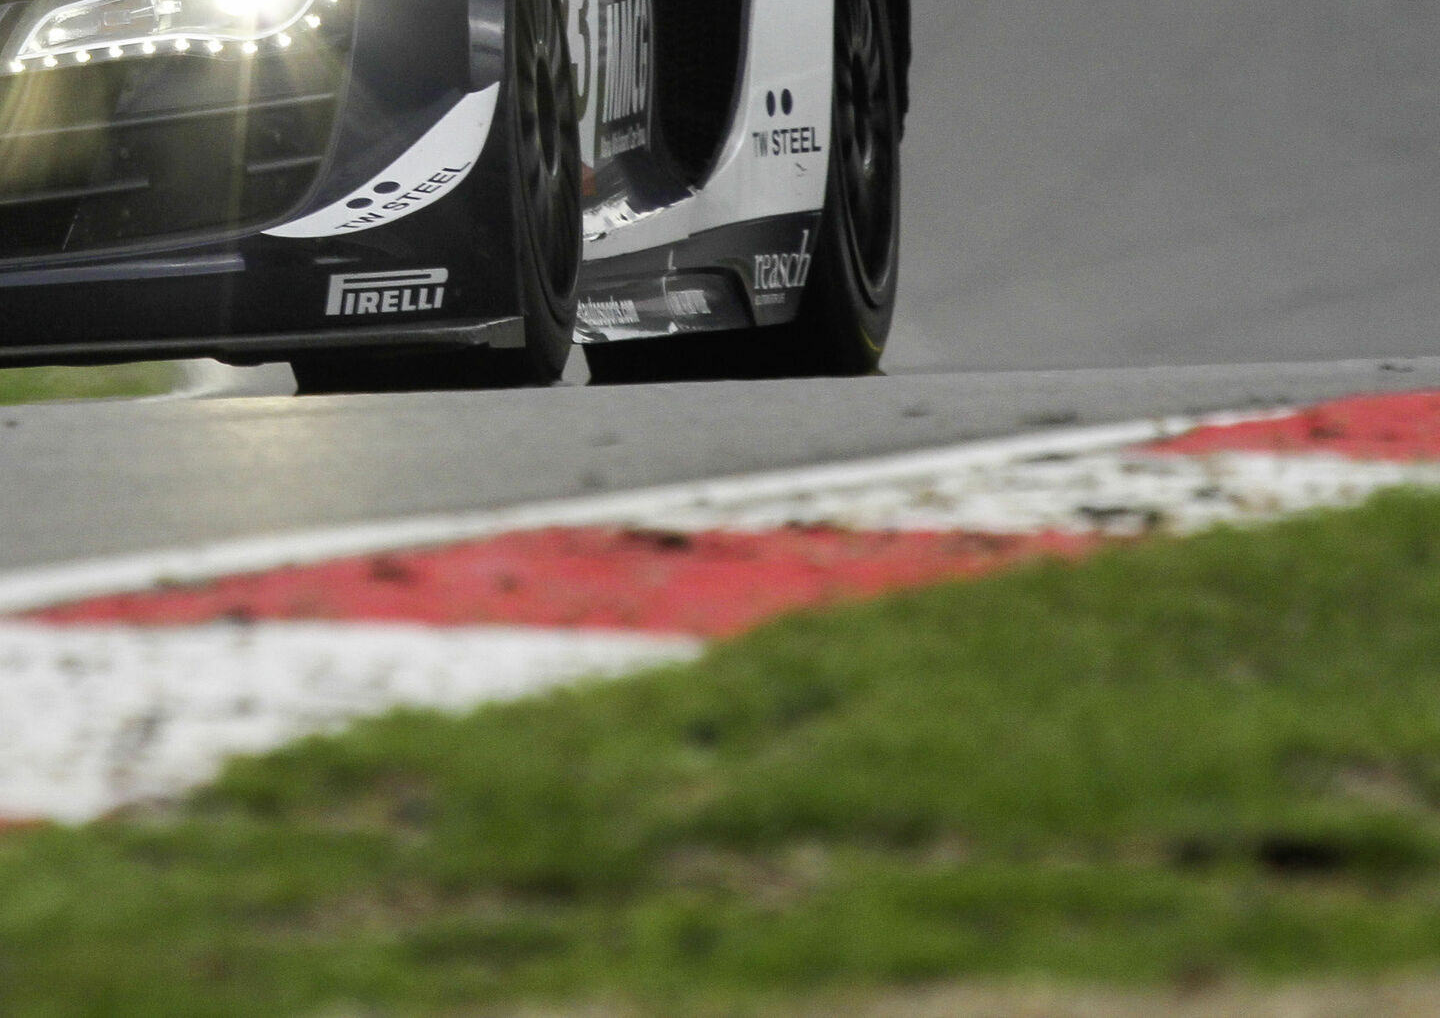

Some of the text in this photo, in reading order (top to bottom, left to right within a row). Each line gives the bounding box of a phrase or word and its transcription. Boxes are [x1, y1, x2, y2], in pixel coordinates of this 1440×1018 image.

[772, 126, 822, 156] STEEL
[334, 161, 472, 231] TW STEEL
[325, 267, 449, 316] PIRELLI
